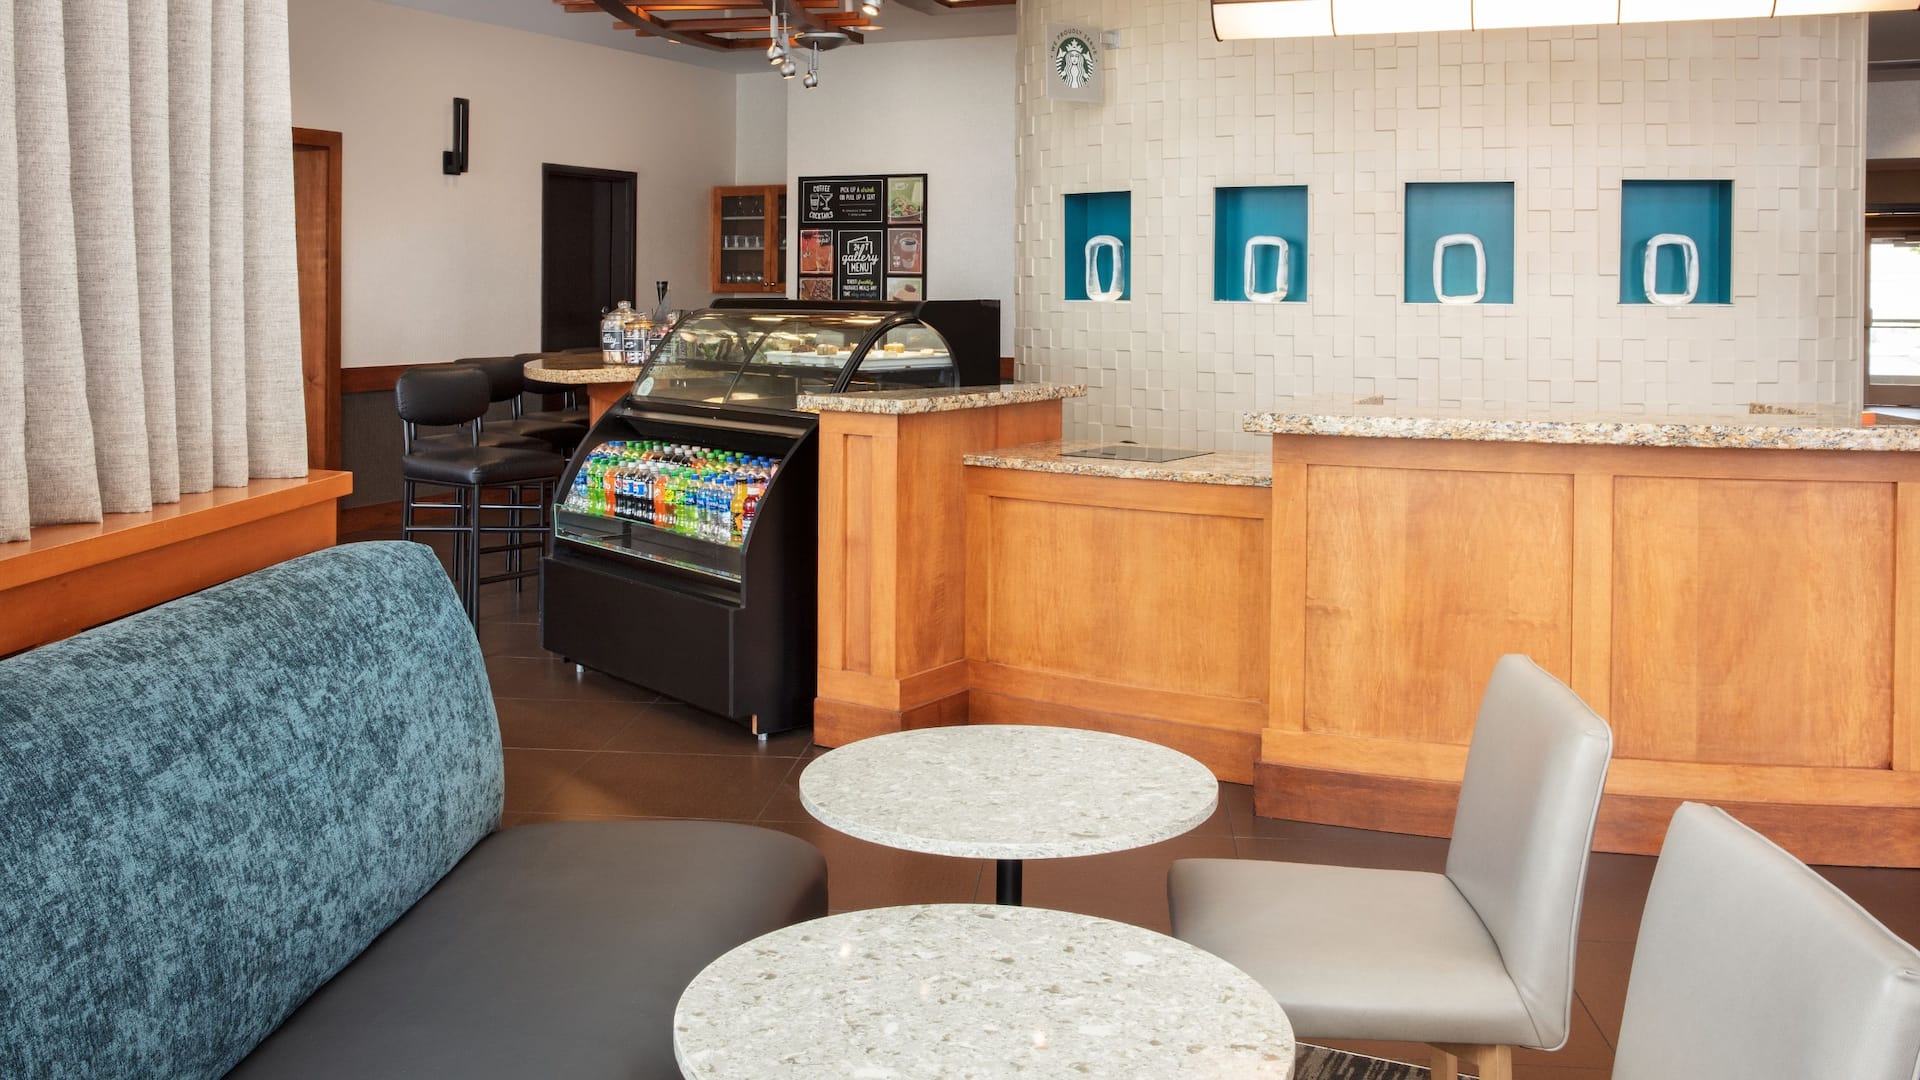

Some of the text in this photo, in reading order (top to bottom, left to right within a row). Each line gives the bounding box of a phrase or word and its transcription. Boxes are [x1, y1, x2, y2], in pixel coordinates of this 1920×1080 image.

[1057, 28, 1082, 40] PROUDLY
[1084, 33, 1097, 54] SERVE
[809, 211, 834, 219] COCKTAILS
[842, 248, 879, 265] gallery
[851, 262, 869, 272] MENU
